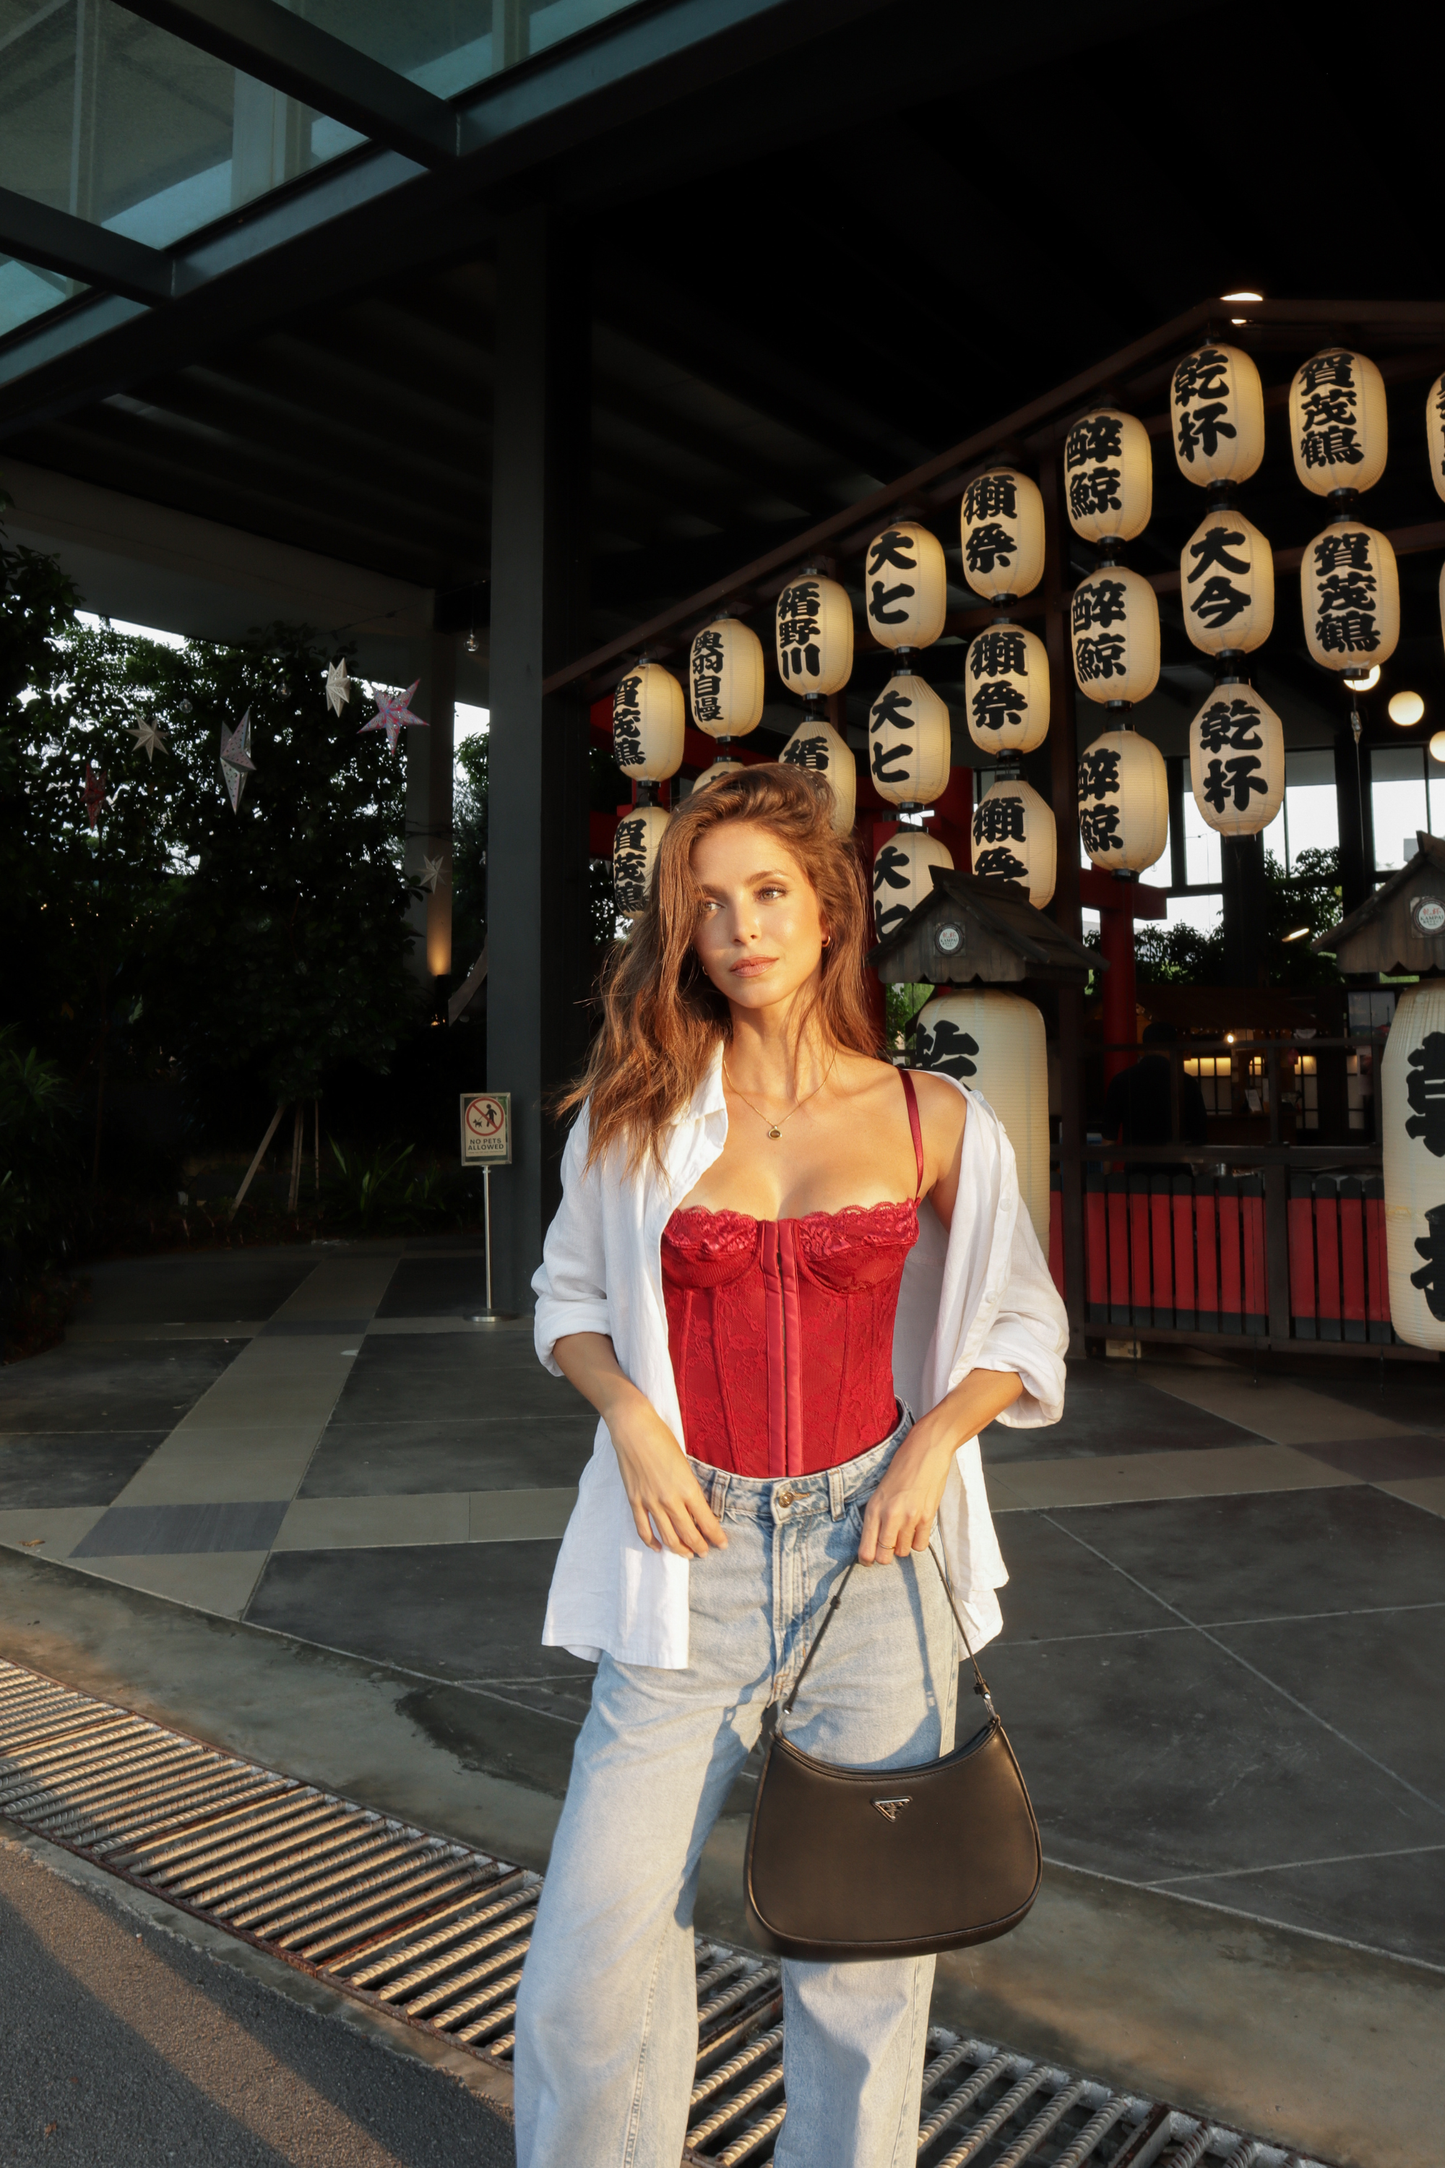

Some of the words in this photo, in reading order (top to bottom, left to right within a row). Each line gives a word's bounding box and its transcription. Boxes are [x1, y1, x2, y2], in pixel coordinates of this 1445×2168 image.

[1299, 352, 1365, 469] 賀茂鶴
[868, 531, 917, 624] 大七
[1314, 532, 1381, 654] 賀茂鶴
[870, 690, 915, 783] 大七
